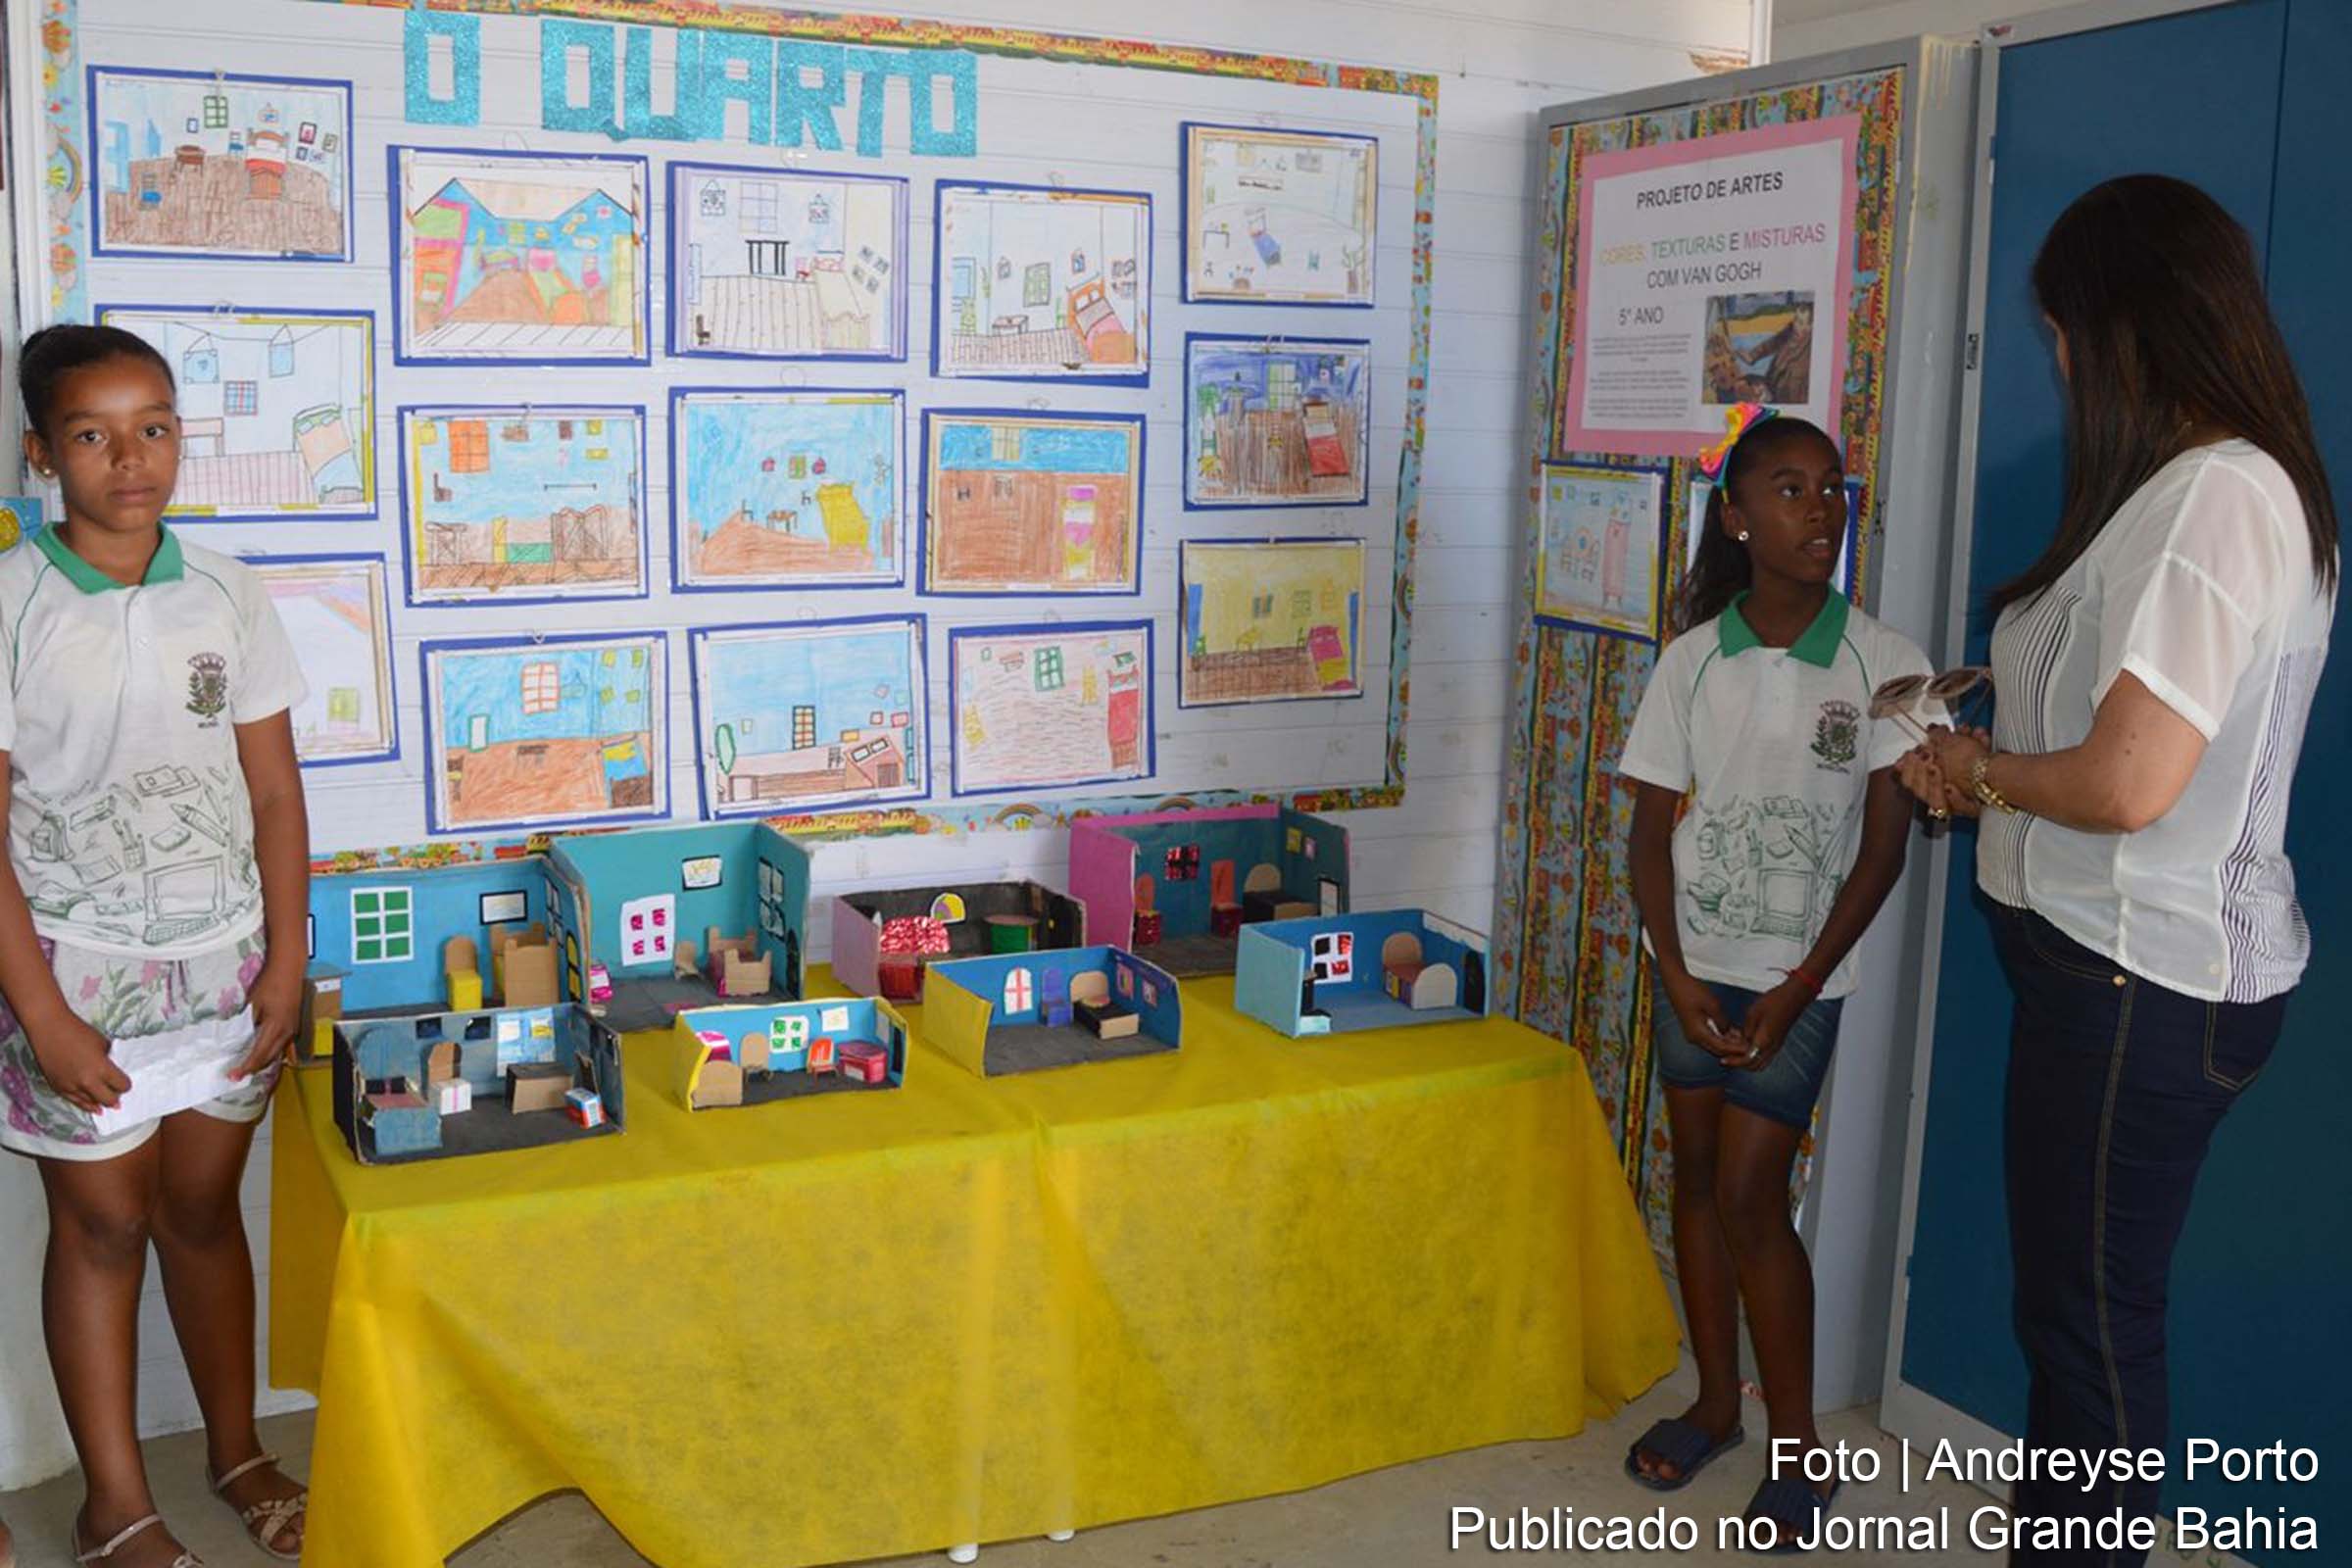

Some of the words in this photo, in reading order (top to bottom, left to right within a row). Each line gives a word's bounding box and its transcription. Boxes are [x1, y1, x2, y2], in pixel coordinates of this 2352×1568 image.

[404, 9, 480, 126] O
[540, 19, 977, 158] QUARTO
[1636, 183, 1702, 209] PROJETO
[1705, 180, 1727, 199] DE
[1729, 172, 1784, 196] ARTES
[1650, 234, 1725, 259] TEXTURAS
[1729, 232, 1740, 251] E
[1743, 223, 1827, 250] MISTURAS
[1647, 270, 1680, 288] COM
[1682, 266, 1711, 285] VAN
[1716, 263, 1762, 283] GOGH
[1634, 306, 1664, 324] ANO
